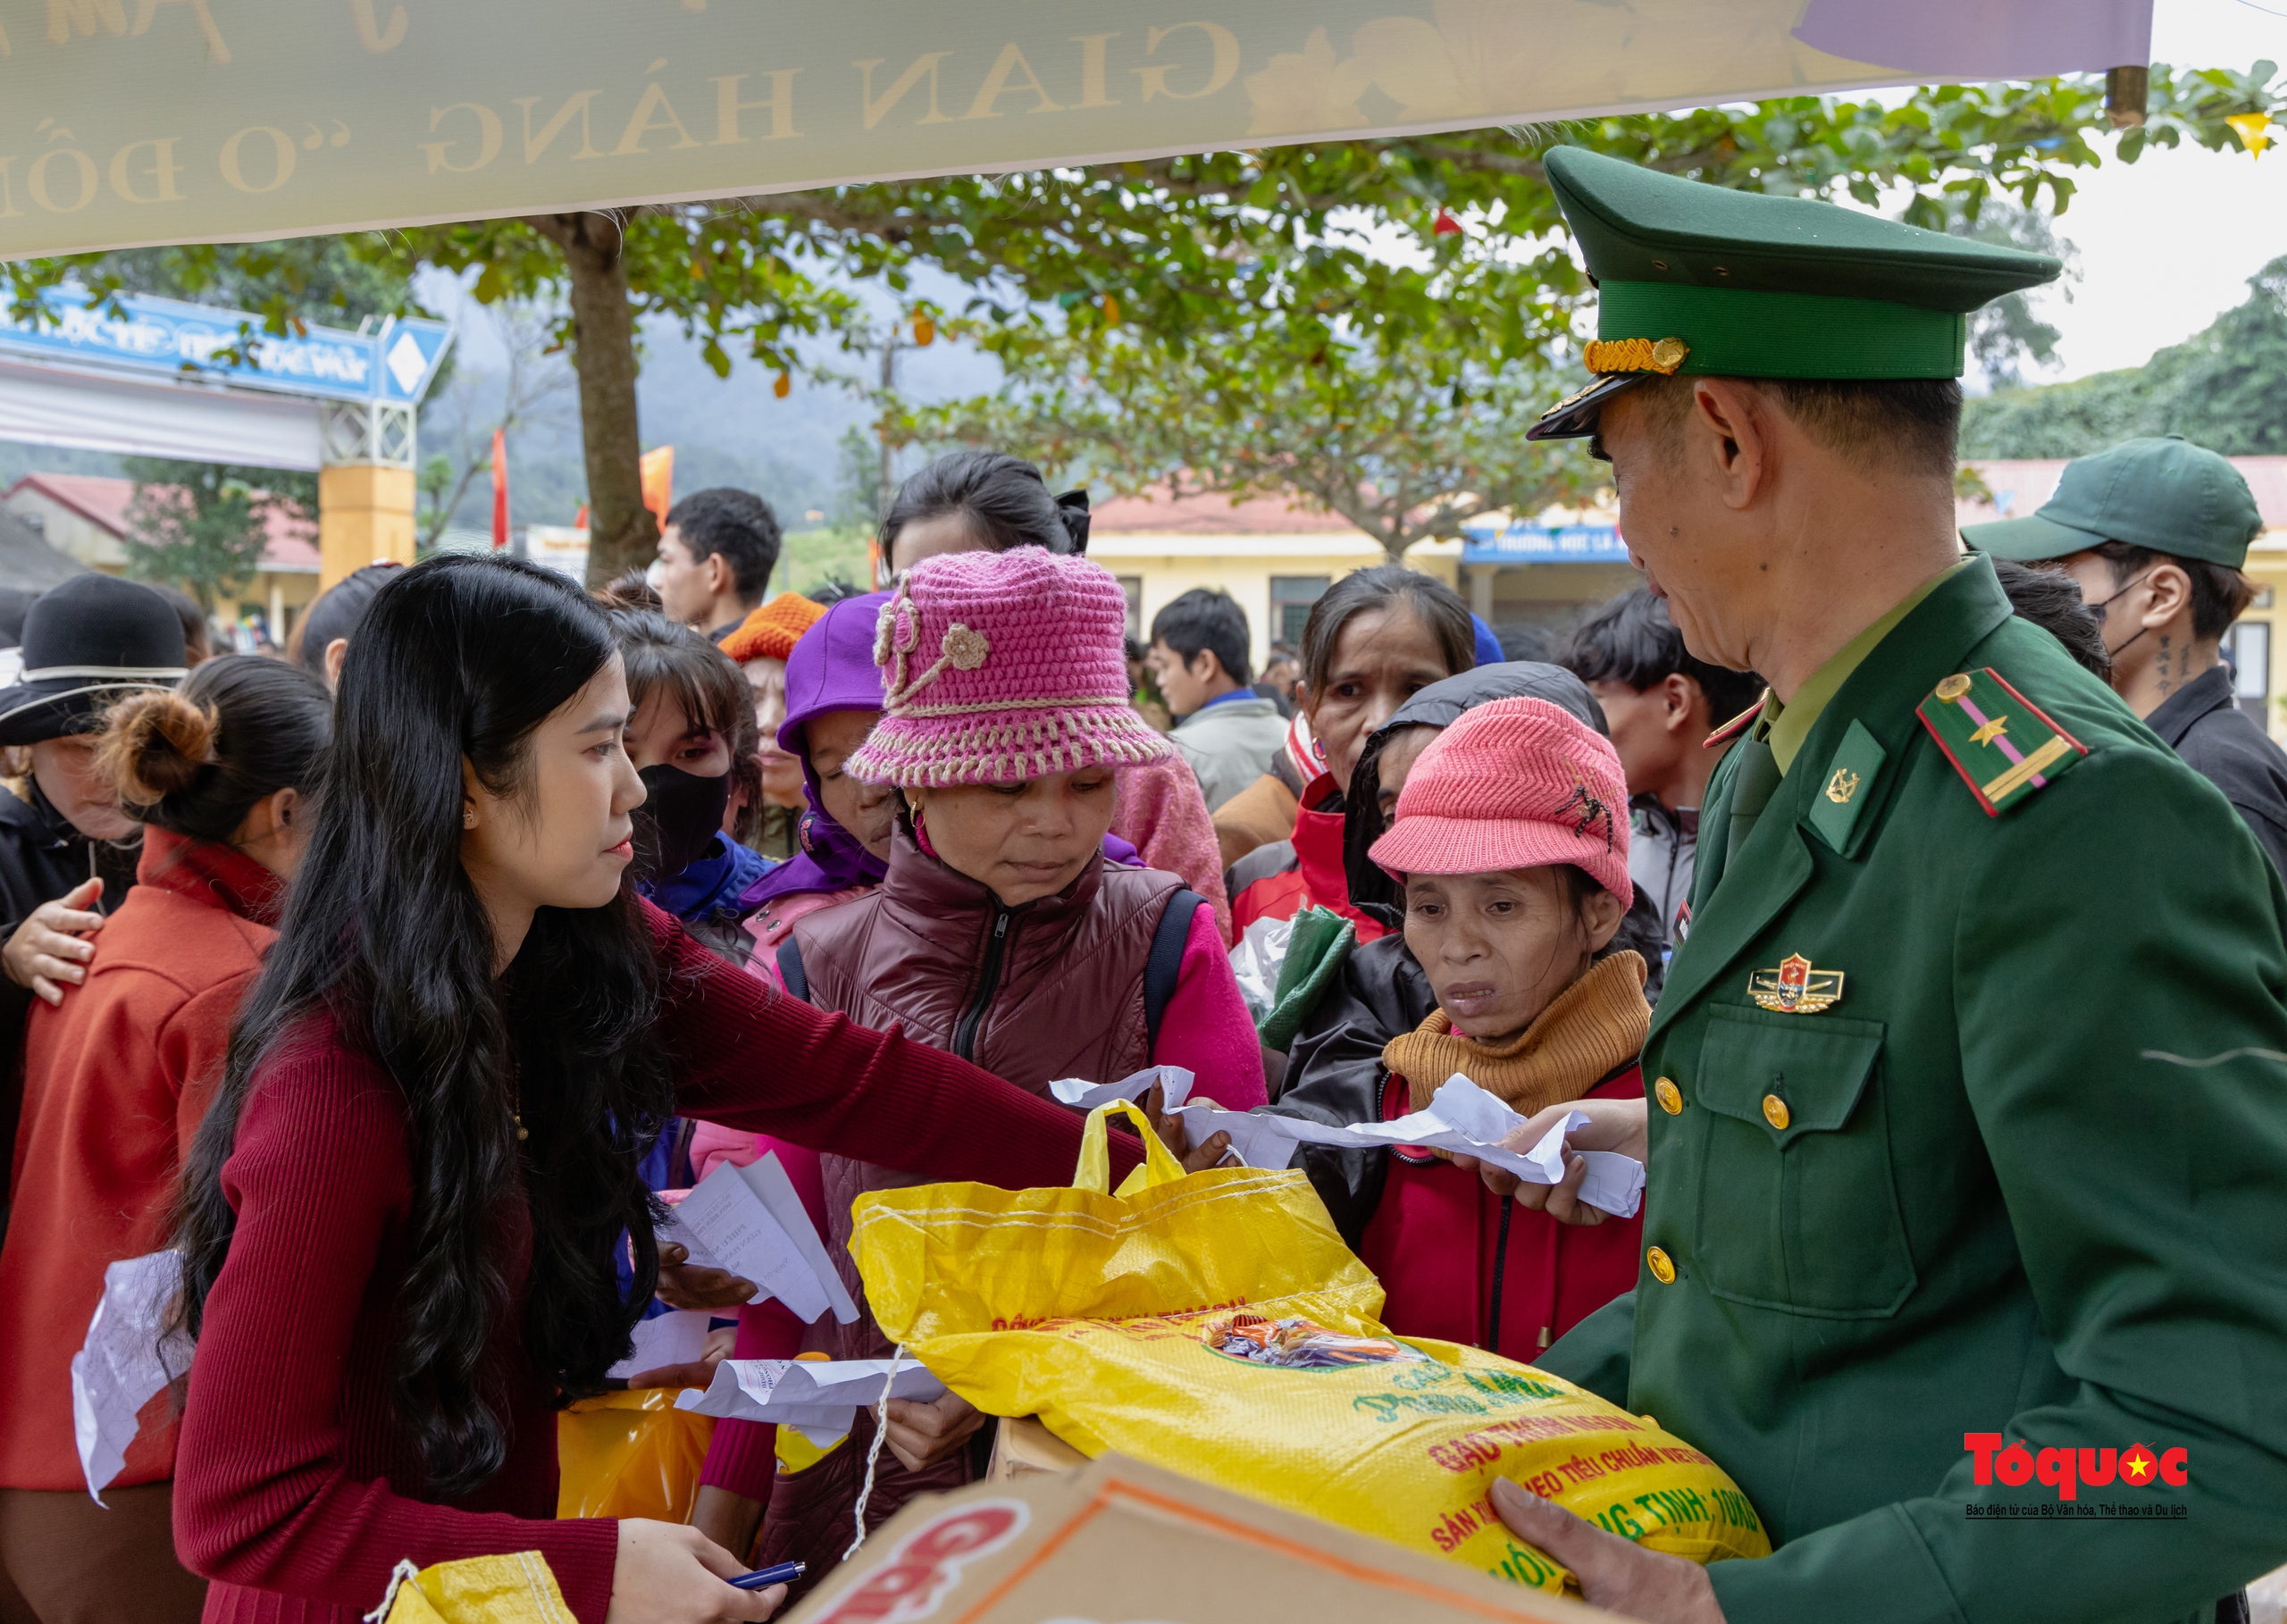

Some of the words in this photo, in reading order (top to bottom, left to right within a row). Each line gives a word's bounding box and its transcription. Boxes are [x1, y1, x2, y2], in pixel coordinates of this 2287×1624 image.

[1428, 1431, 1502, 1477] GẠO
[1430, 1511, 1480, 1553] SẢN
[1556, 1453, 1607, 1486] TIÊU
[1599, 1438, 1664, 1472] CHUẨN
